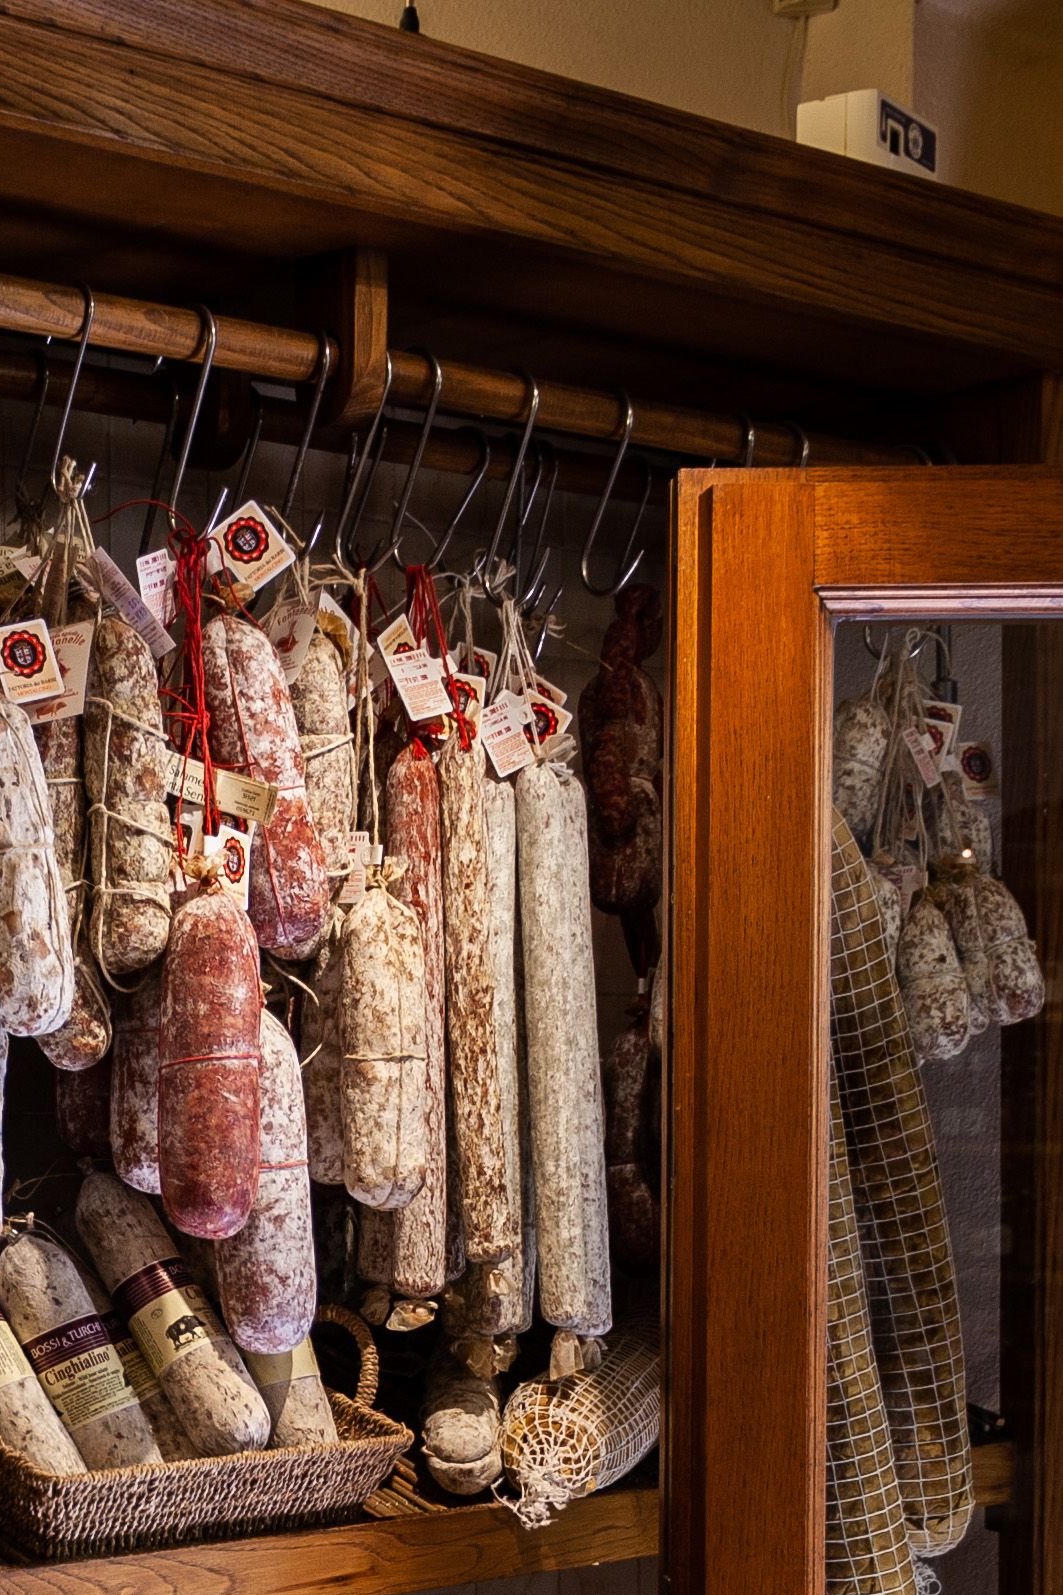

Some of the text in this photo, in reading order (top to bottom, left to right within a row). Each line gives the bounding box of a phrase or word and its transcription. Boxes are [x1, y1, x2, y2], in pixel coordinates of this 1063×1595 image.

[30, 1338, 61, 1359] BOSSI
[67, 1321, 101, 1342] TURCHI
[44, 1350, 110, 1387] Cinghialino
